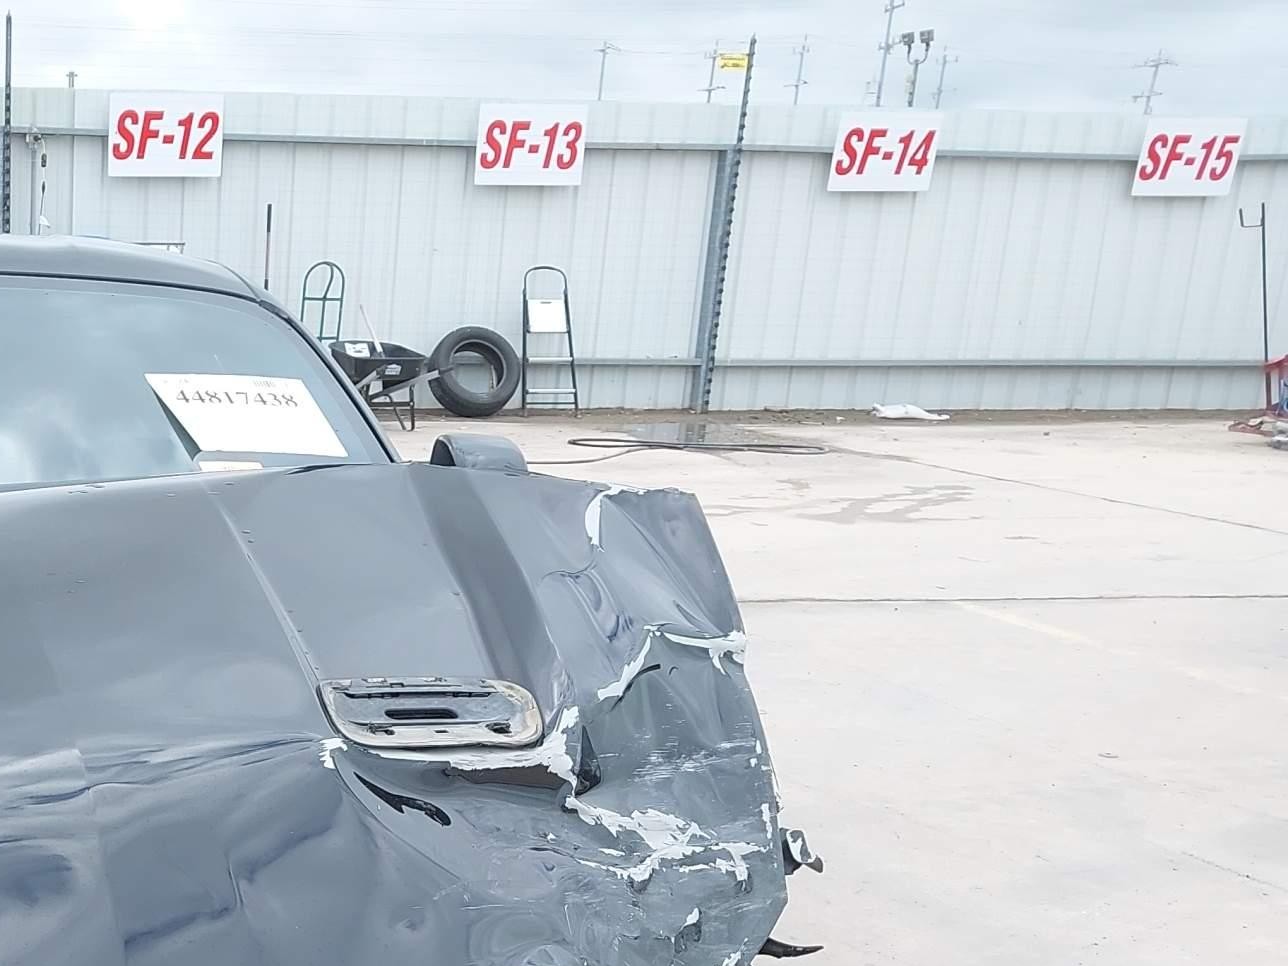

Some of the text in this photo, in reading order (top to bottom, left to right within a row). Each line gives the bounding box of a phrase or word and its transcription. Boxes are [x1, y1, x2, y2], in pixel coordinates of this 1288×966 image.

[112, 109, 220, 160] SF-12
[479, 119, 583, 170] SF-13
[834, 127, 936, 176] SF-14
[1138, 133, 1241, 181] SF-15
[176, 389, 299, 407] 44817438
